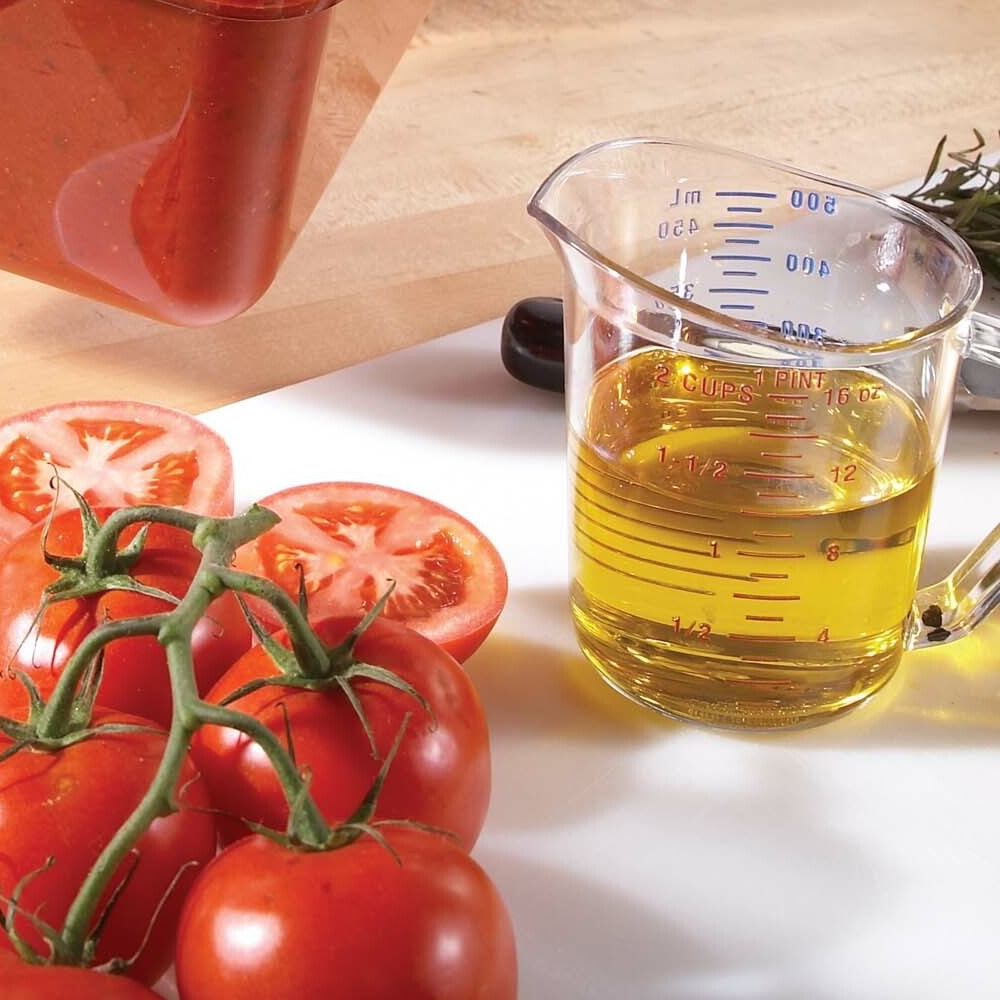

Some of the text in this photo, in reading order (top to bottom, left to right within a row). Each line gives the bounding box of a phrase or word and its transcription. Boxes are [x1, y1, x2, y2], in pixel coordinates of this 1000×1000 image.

[654, 364, 754, 403] 2 CUPS
[753, 368, 828, 390] 1 PINT
[824, 387, 849, 406] 16
[831, 464, 858, 484] 12
[710, 540, 720, 559] 1
[826, 542, 841, 562] 8
[671, 615, 712, 642] 1/2
[817, 626, 831, 643] 4
